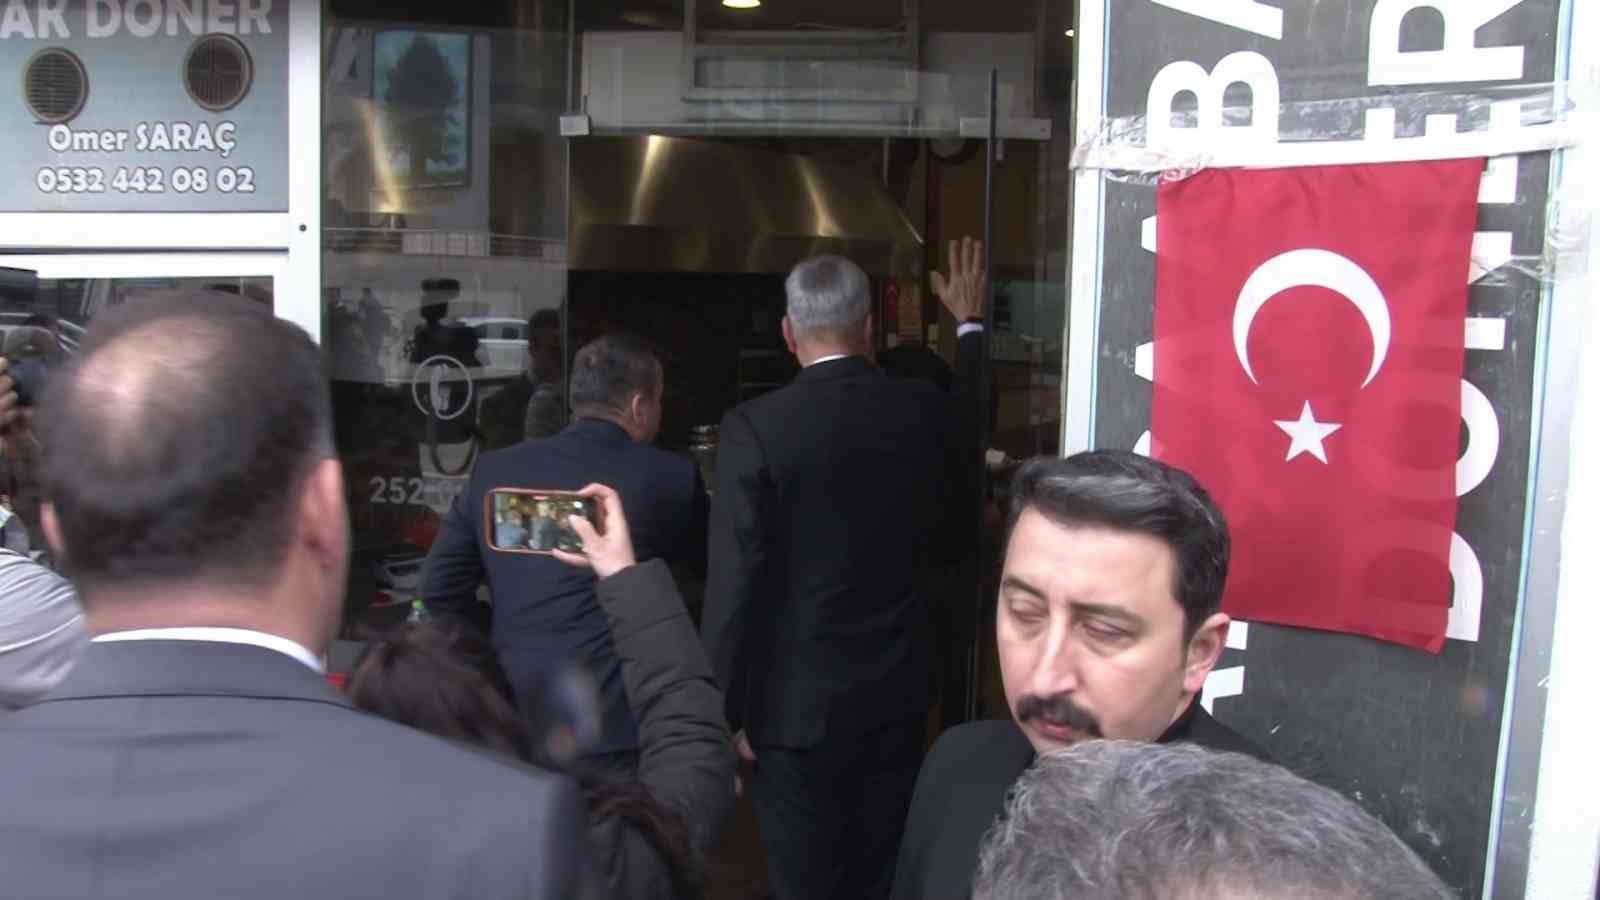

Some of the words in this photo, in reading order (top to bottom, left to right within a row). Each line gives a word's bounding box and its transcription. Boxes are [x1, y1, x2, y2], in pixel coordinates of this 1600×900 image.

[136, 121, 236, 156] SARAÇ
[37, 167, 105, 192] 0532
[112, 168, 164, 192] 442
[172, 168, 209, 192] 08
[216, 168, 255, 192] 02
